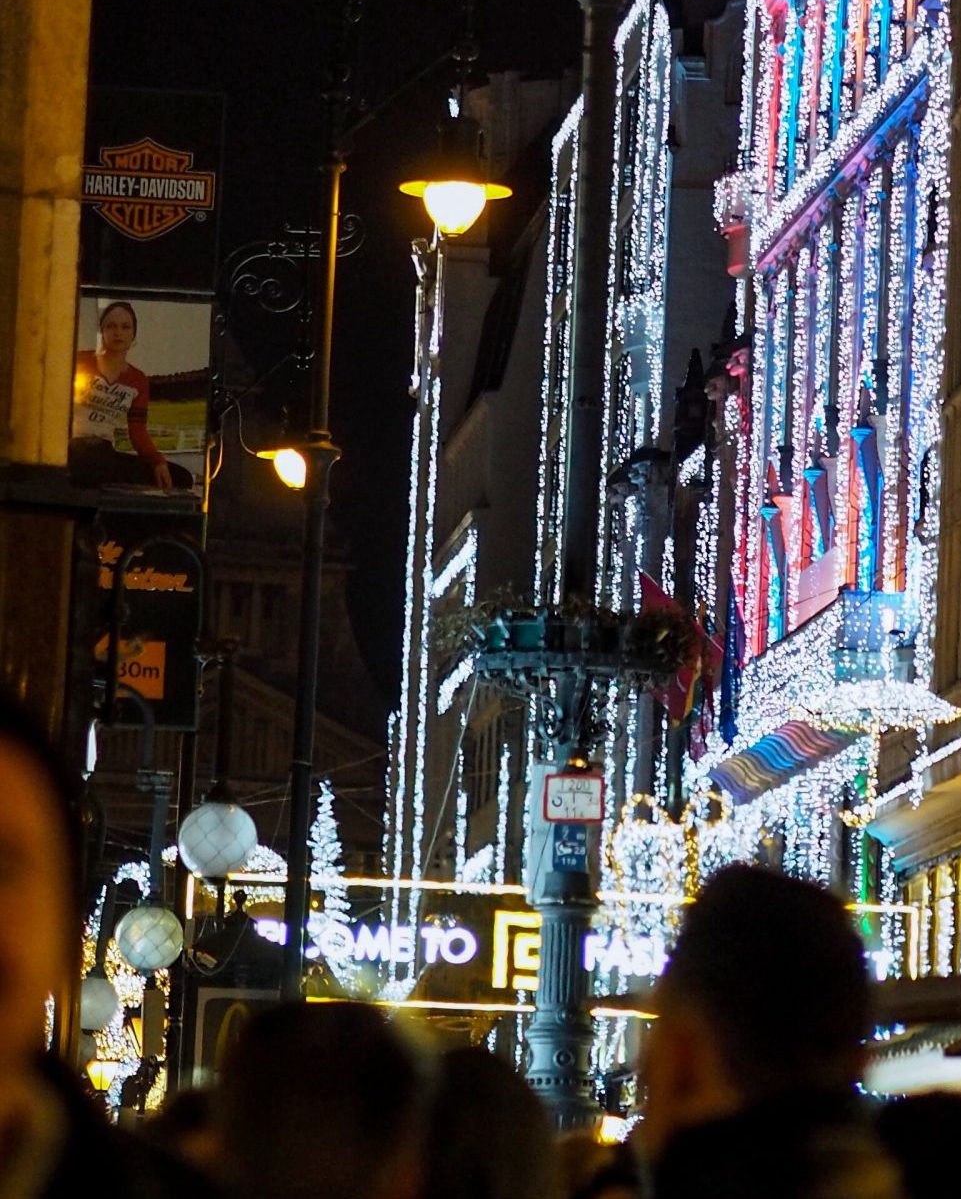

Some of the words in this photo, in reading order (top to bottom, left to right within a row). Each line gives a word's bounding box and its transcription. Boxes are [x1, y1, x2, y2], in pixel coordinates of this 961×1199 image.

[115, 152, 179, 171] MOTOR
[85, 174, 205, 200] HARLEY-DAVIDSON
[111, 203, 175, 232] CYCLES
[420, 926, 478, 965] TO
